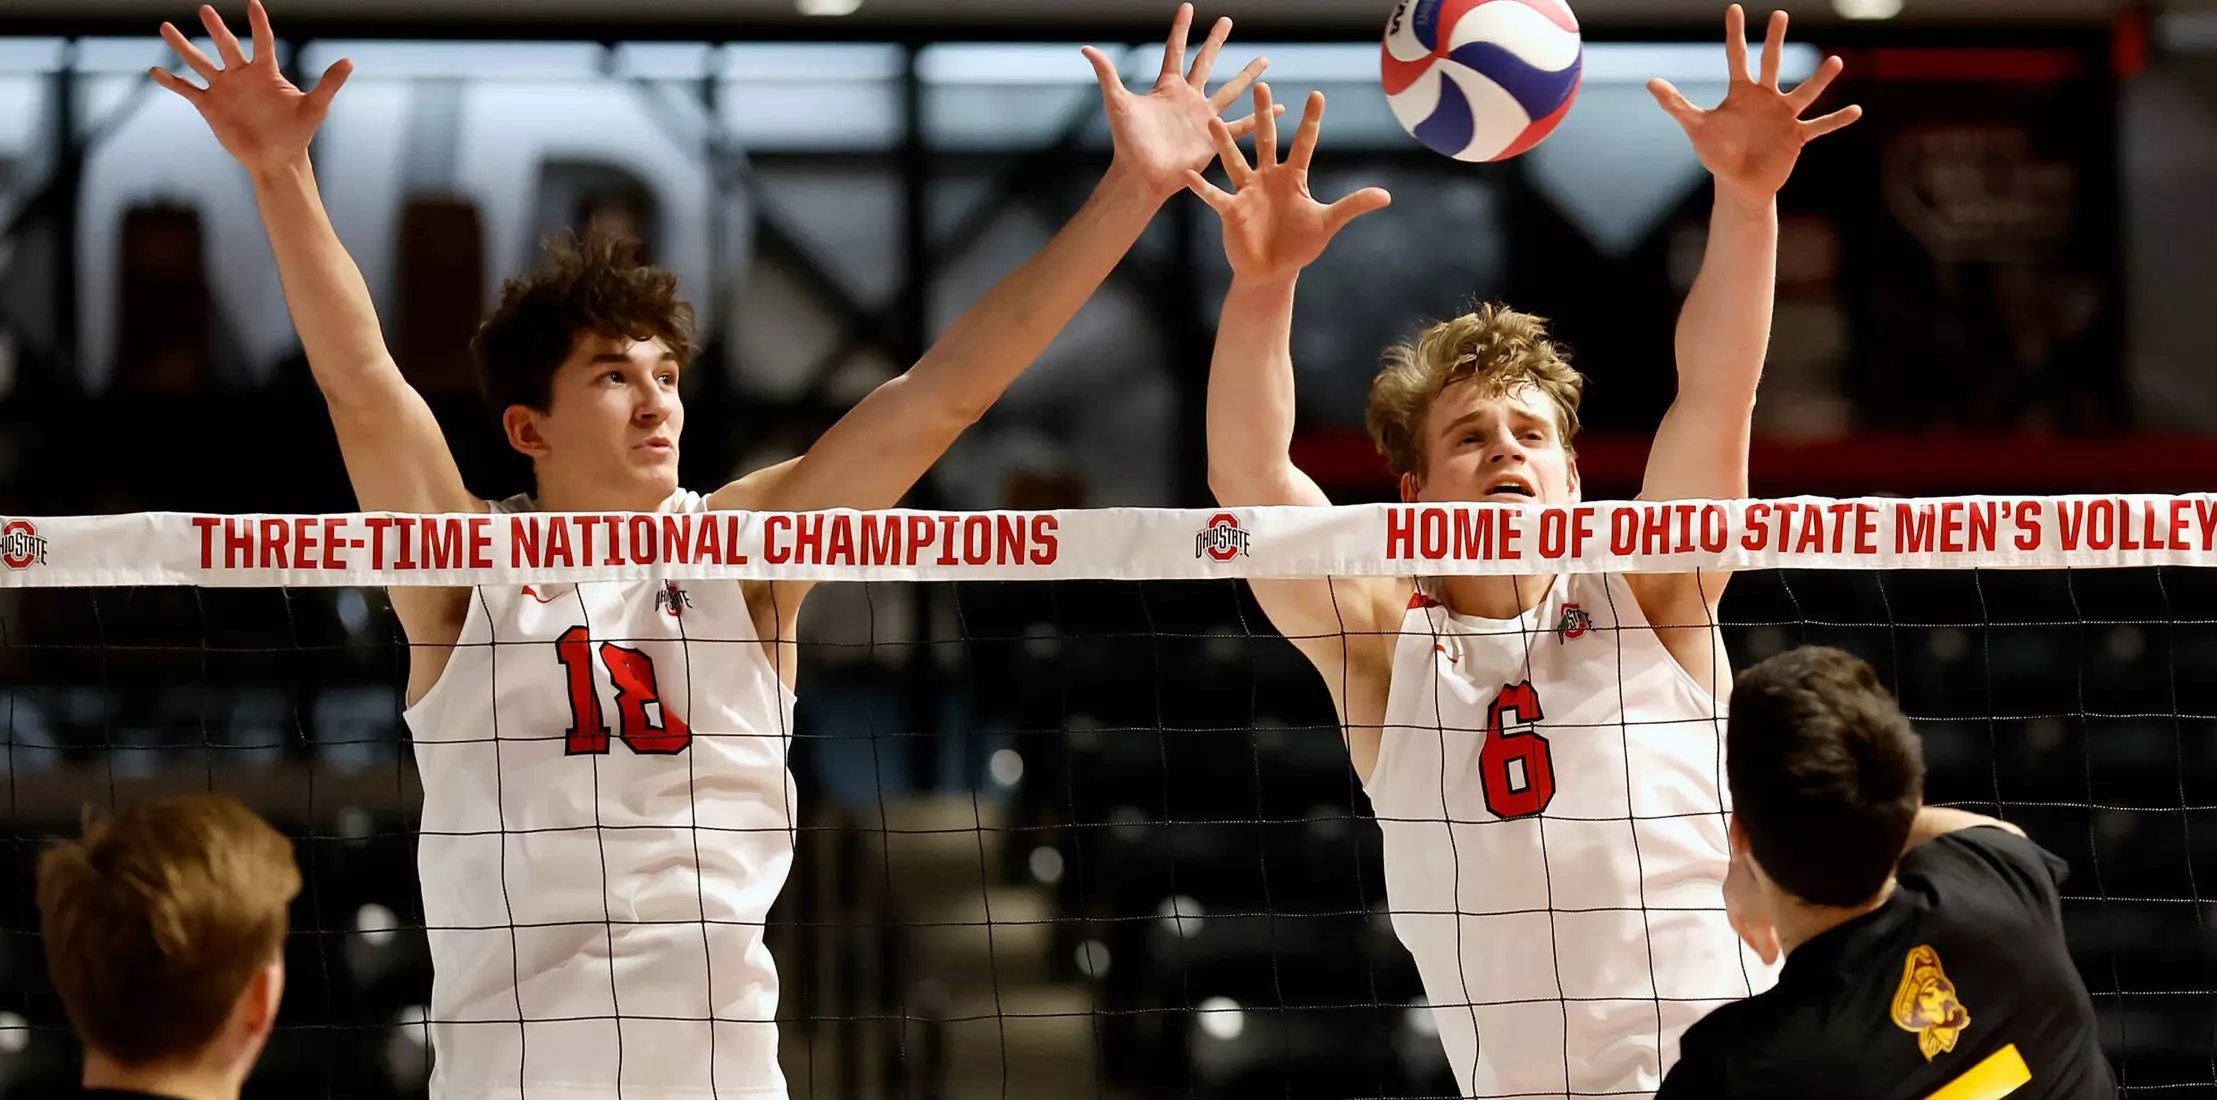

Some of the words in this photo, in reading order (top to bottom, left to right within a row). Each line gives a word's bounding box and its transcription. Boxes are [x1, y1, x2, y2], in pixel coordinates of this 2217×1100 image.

[192, 517, 494, 571] THREE-TIME
[511, 514, 748, 569] NATIONAL
[763, 514, 1059, 566] CHAMPIONS
[1386, 507, 1522, 560] HOME
[1538, 508, 1595, 559] OF
[1610, 504, 1728, 556] OHIO
[1740, 503, 1878, 555] STATE
[1895, 500, 2042, 554] MEN'S
[2057, 499, 2217, 551] VOLLEY
[555, 625, 693, 756] 18
[1478, 679, 1556, 822] 6
